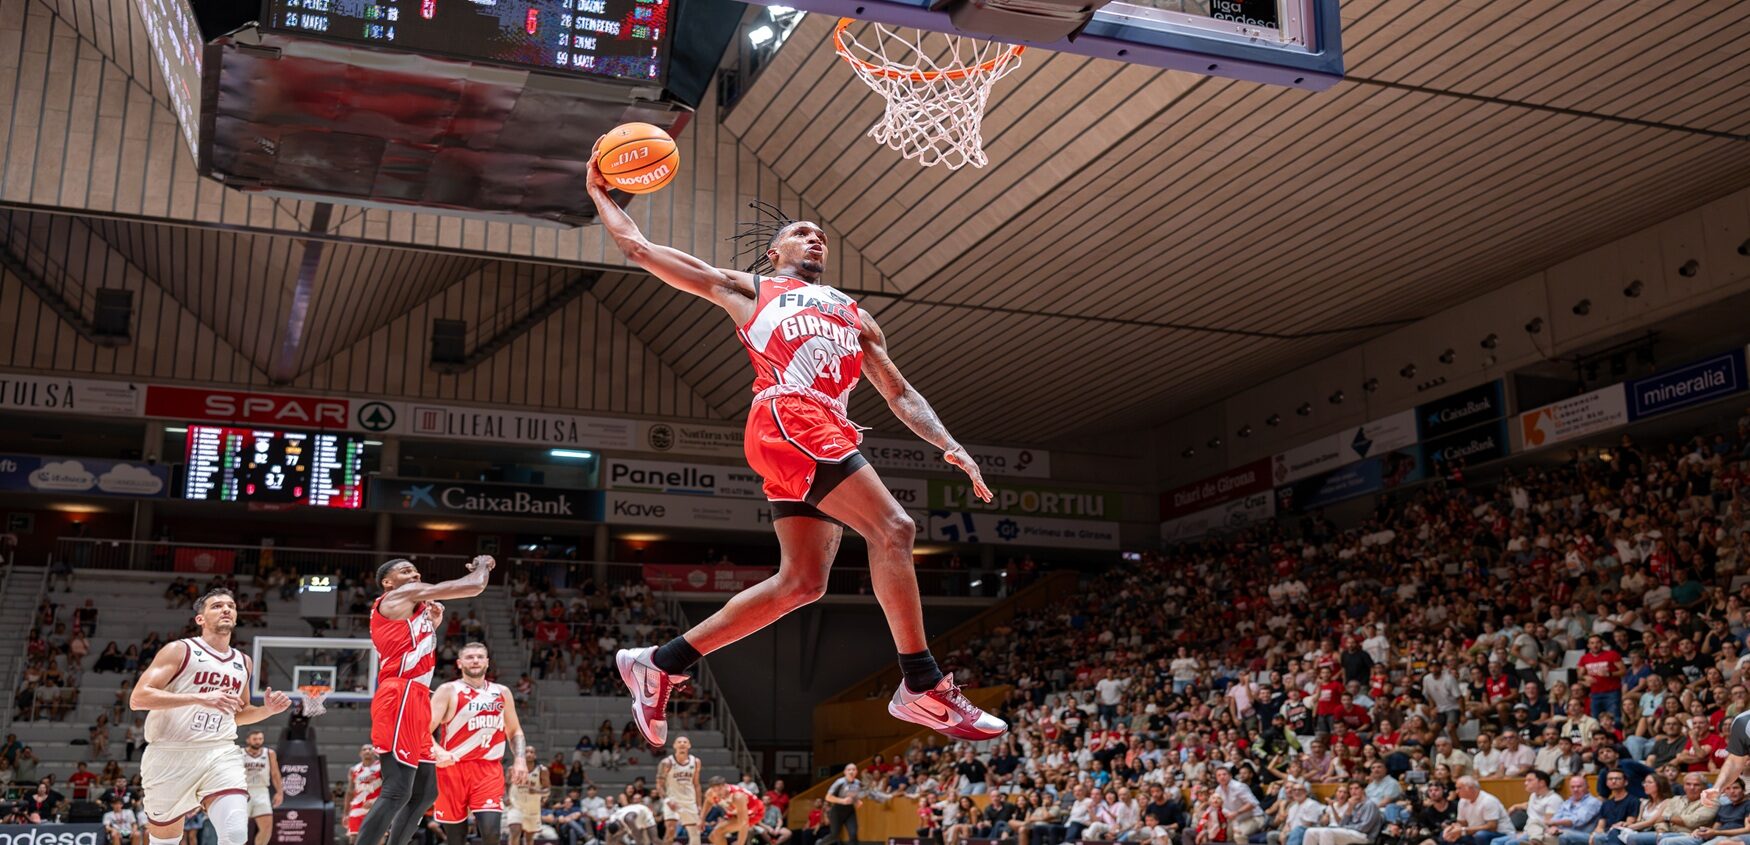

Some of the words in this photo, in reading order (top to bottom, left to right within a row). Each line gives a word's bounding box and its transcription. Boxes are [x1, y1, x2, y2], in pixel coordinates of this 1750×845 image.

[616, 164, 670, 185] Wilson
[813, 348, 842, 383] 24
[1643, 369, 1726, 406] mineralia
[205, 395, 345, 423] SPAR
[1440, 396, 1492, 422] CaixaBank
[448, 412, 506, 438] LLEAL
[611, 463, 715, 488] Panella
[441, 487, 573, 515] CaixaBank
[613, 500, 666, 518] Kave
[193, 671, 242, 692] UCAM
[190, 711, 223, 733] 99
[467, 714, 504, 732] GIRONA
